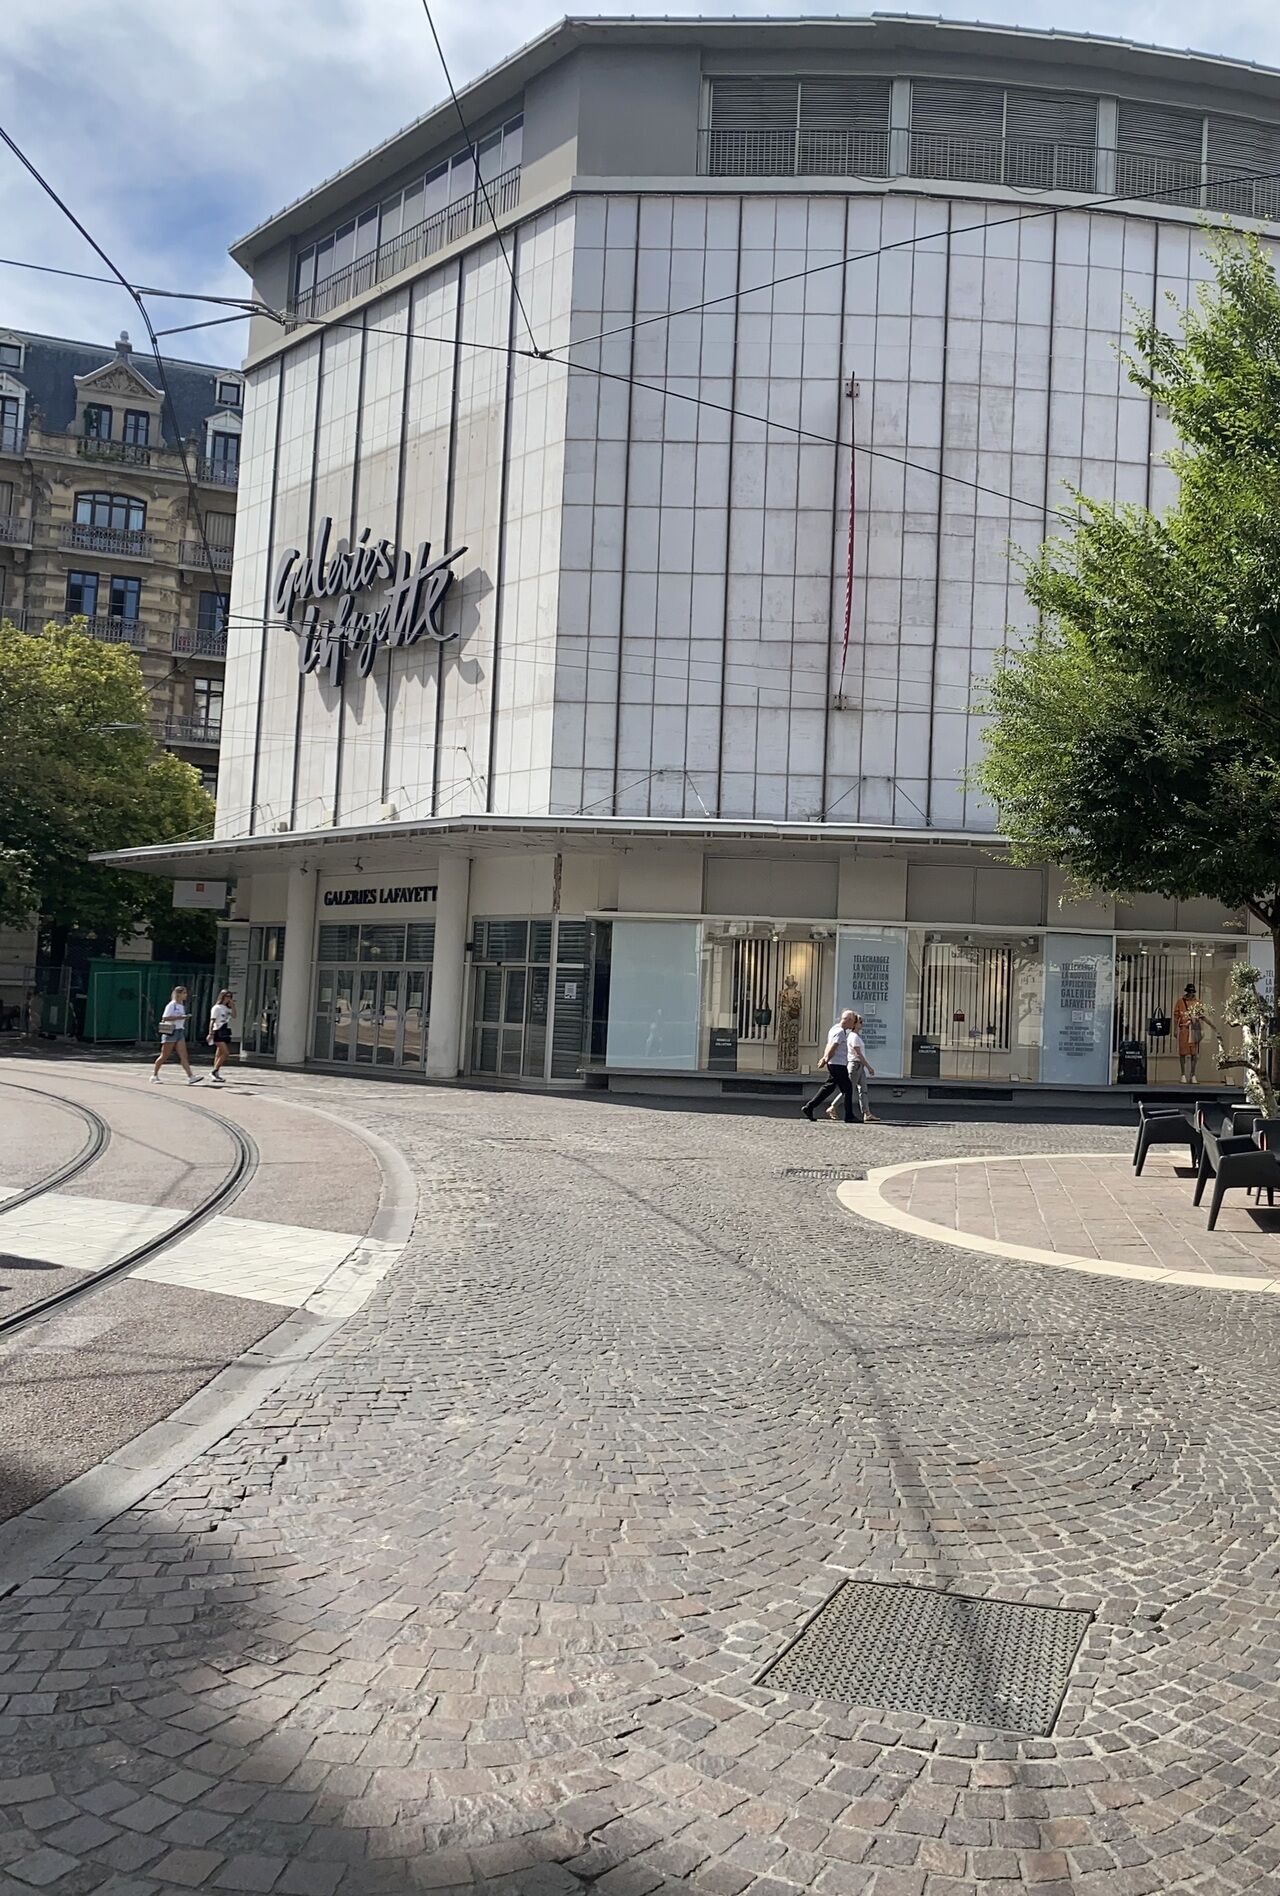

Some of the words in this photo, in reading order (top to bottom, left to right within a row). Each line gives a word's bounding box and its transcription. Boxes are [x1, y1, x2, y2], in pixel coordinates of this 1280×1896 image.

[274, 516, 396, 631] Galeries
[300, 541, 469, 687] Lafayette
[324, 888, 377, 906] GALERIES
[379, 885, 438, 903] LAFAYETT
[852, 981, 889, 991] GALERIES
[852, 991, 889, 1001] LAFAYETTE
[1061, 989, 1097, 998] GALERIES
[1060, 999, 1096, 1009] LAFAYETTE
